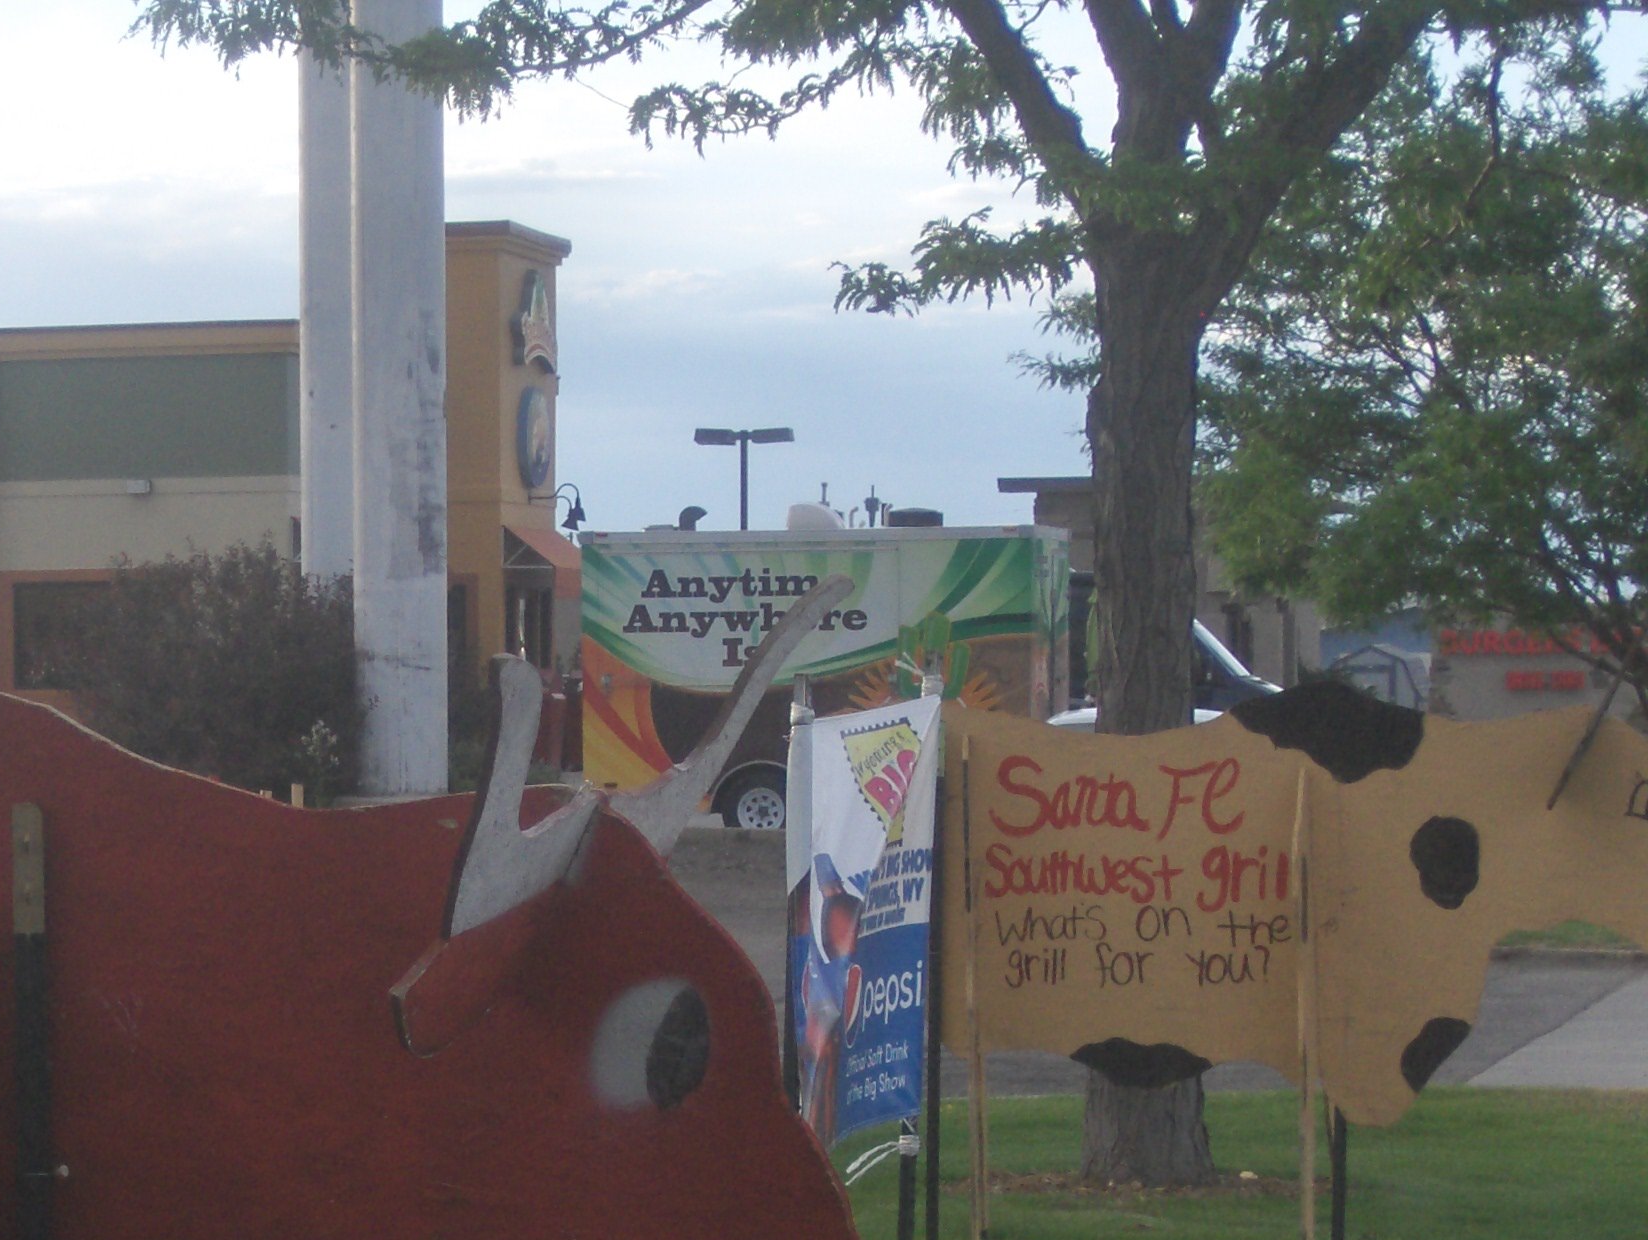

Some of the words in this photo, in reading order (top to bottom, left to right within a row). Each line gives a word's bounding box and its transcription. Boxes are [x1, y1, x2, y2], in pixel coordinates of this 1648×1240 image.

[641, 567, 819, 604] Anytim
[623, 603, 868, 639] Anywhre
[988, 755, 1150, 839] Santa
[1156, 757, 1246, 842] Fe
[985, 843, 1184, 903] Southwest
[1135, 904, 1192, 942] on
[1217, 910, 1291, 948] the
[1004, 948, 1066, 988] grill
[1096, 942, 1154, 988] for
[862, 959, 923, 1032] pepsi
[885, 1040, 908, 1064] Drink
[878, 1071, 906, 1093] Show
